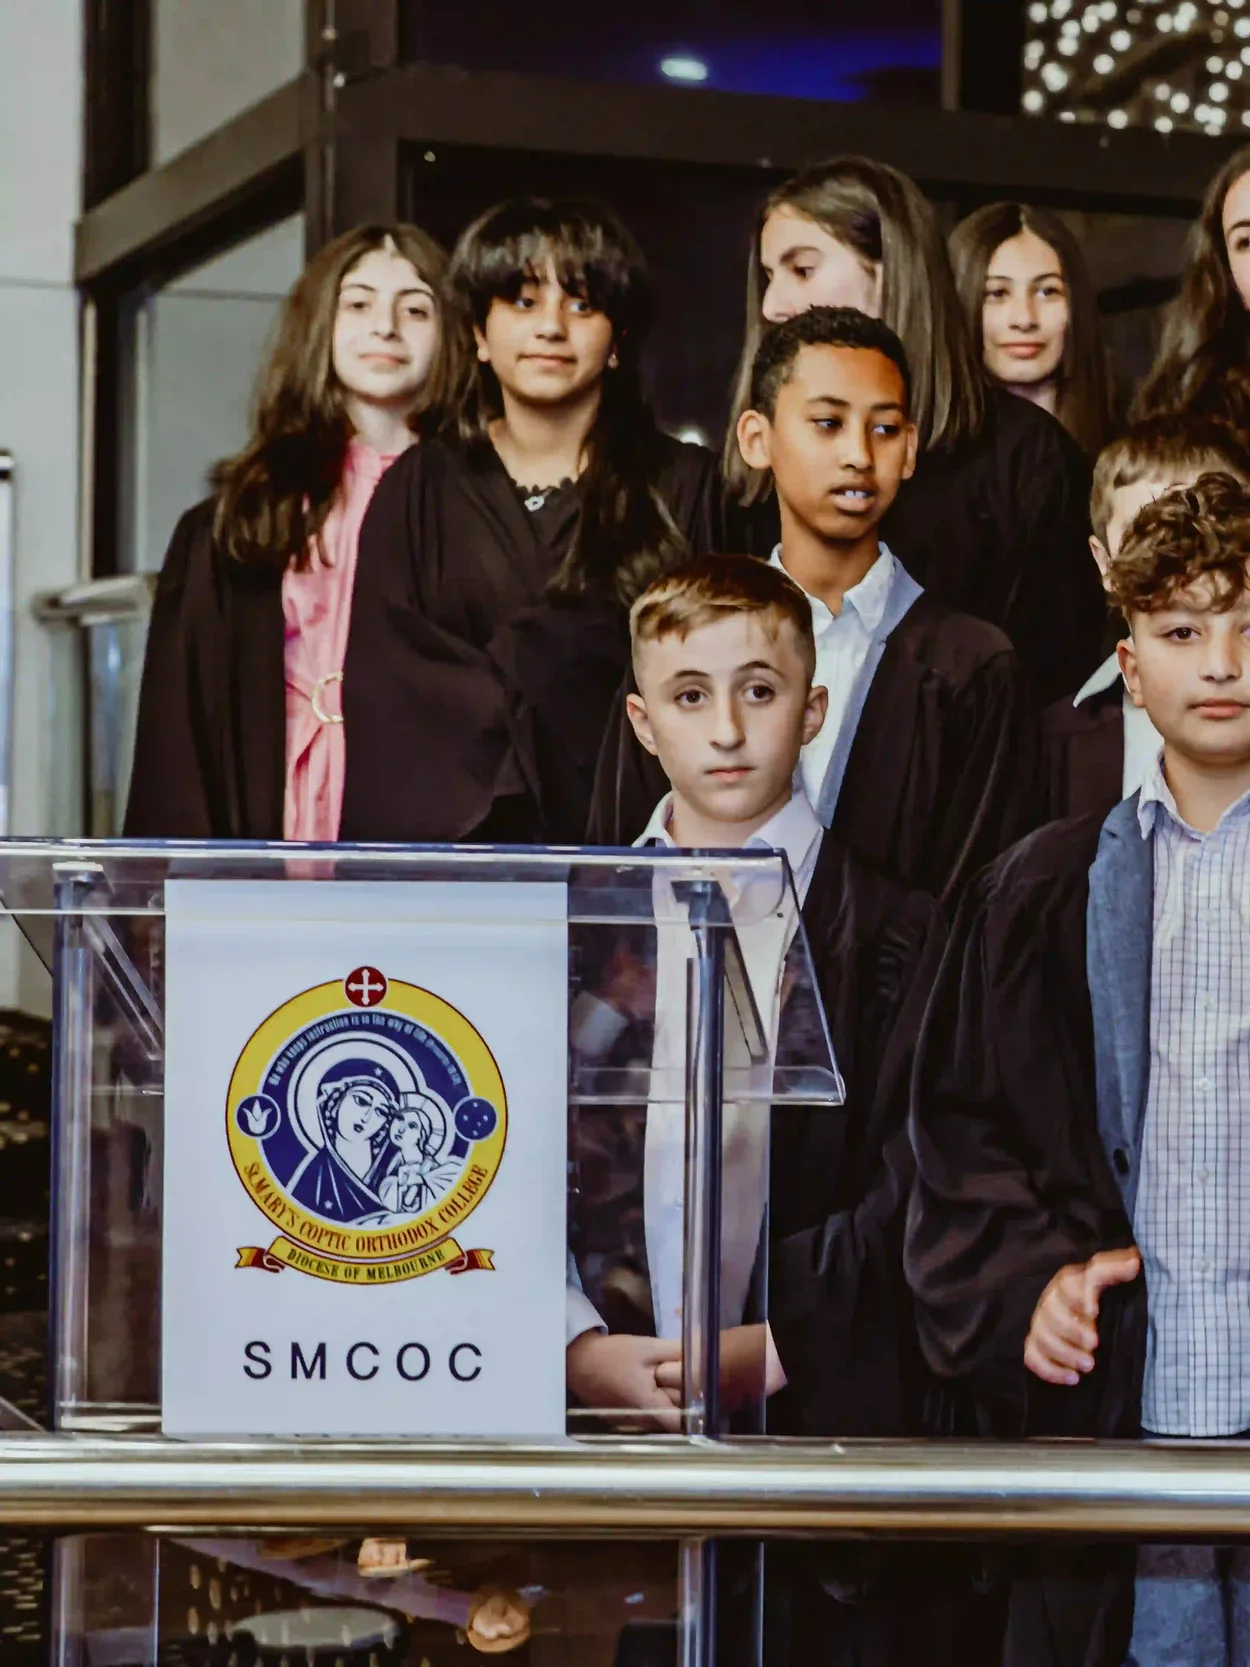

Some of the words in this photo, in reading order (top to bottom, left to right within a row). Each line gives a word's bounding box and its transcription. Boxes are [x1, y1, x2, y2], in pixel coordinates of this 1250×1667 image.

[299, 1220, 351, 1252] COPTIC
[355, 1217, 439, 1253] ORTHODOX
[438, 1164, 488, 1224] COLLEGE
[286, 1248, 340, 1278] DIOCESE
[344, 1265, 361, 1280] OF
[366, 1248, 446, 1281] MELBOURNE
[243, 1340, 482, 1382] SMCOC
